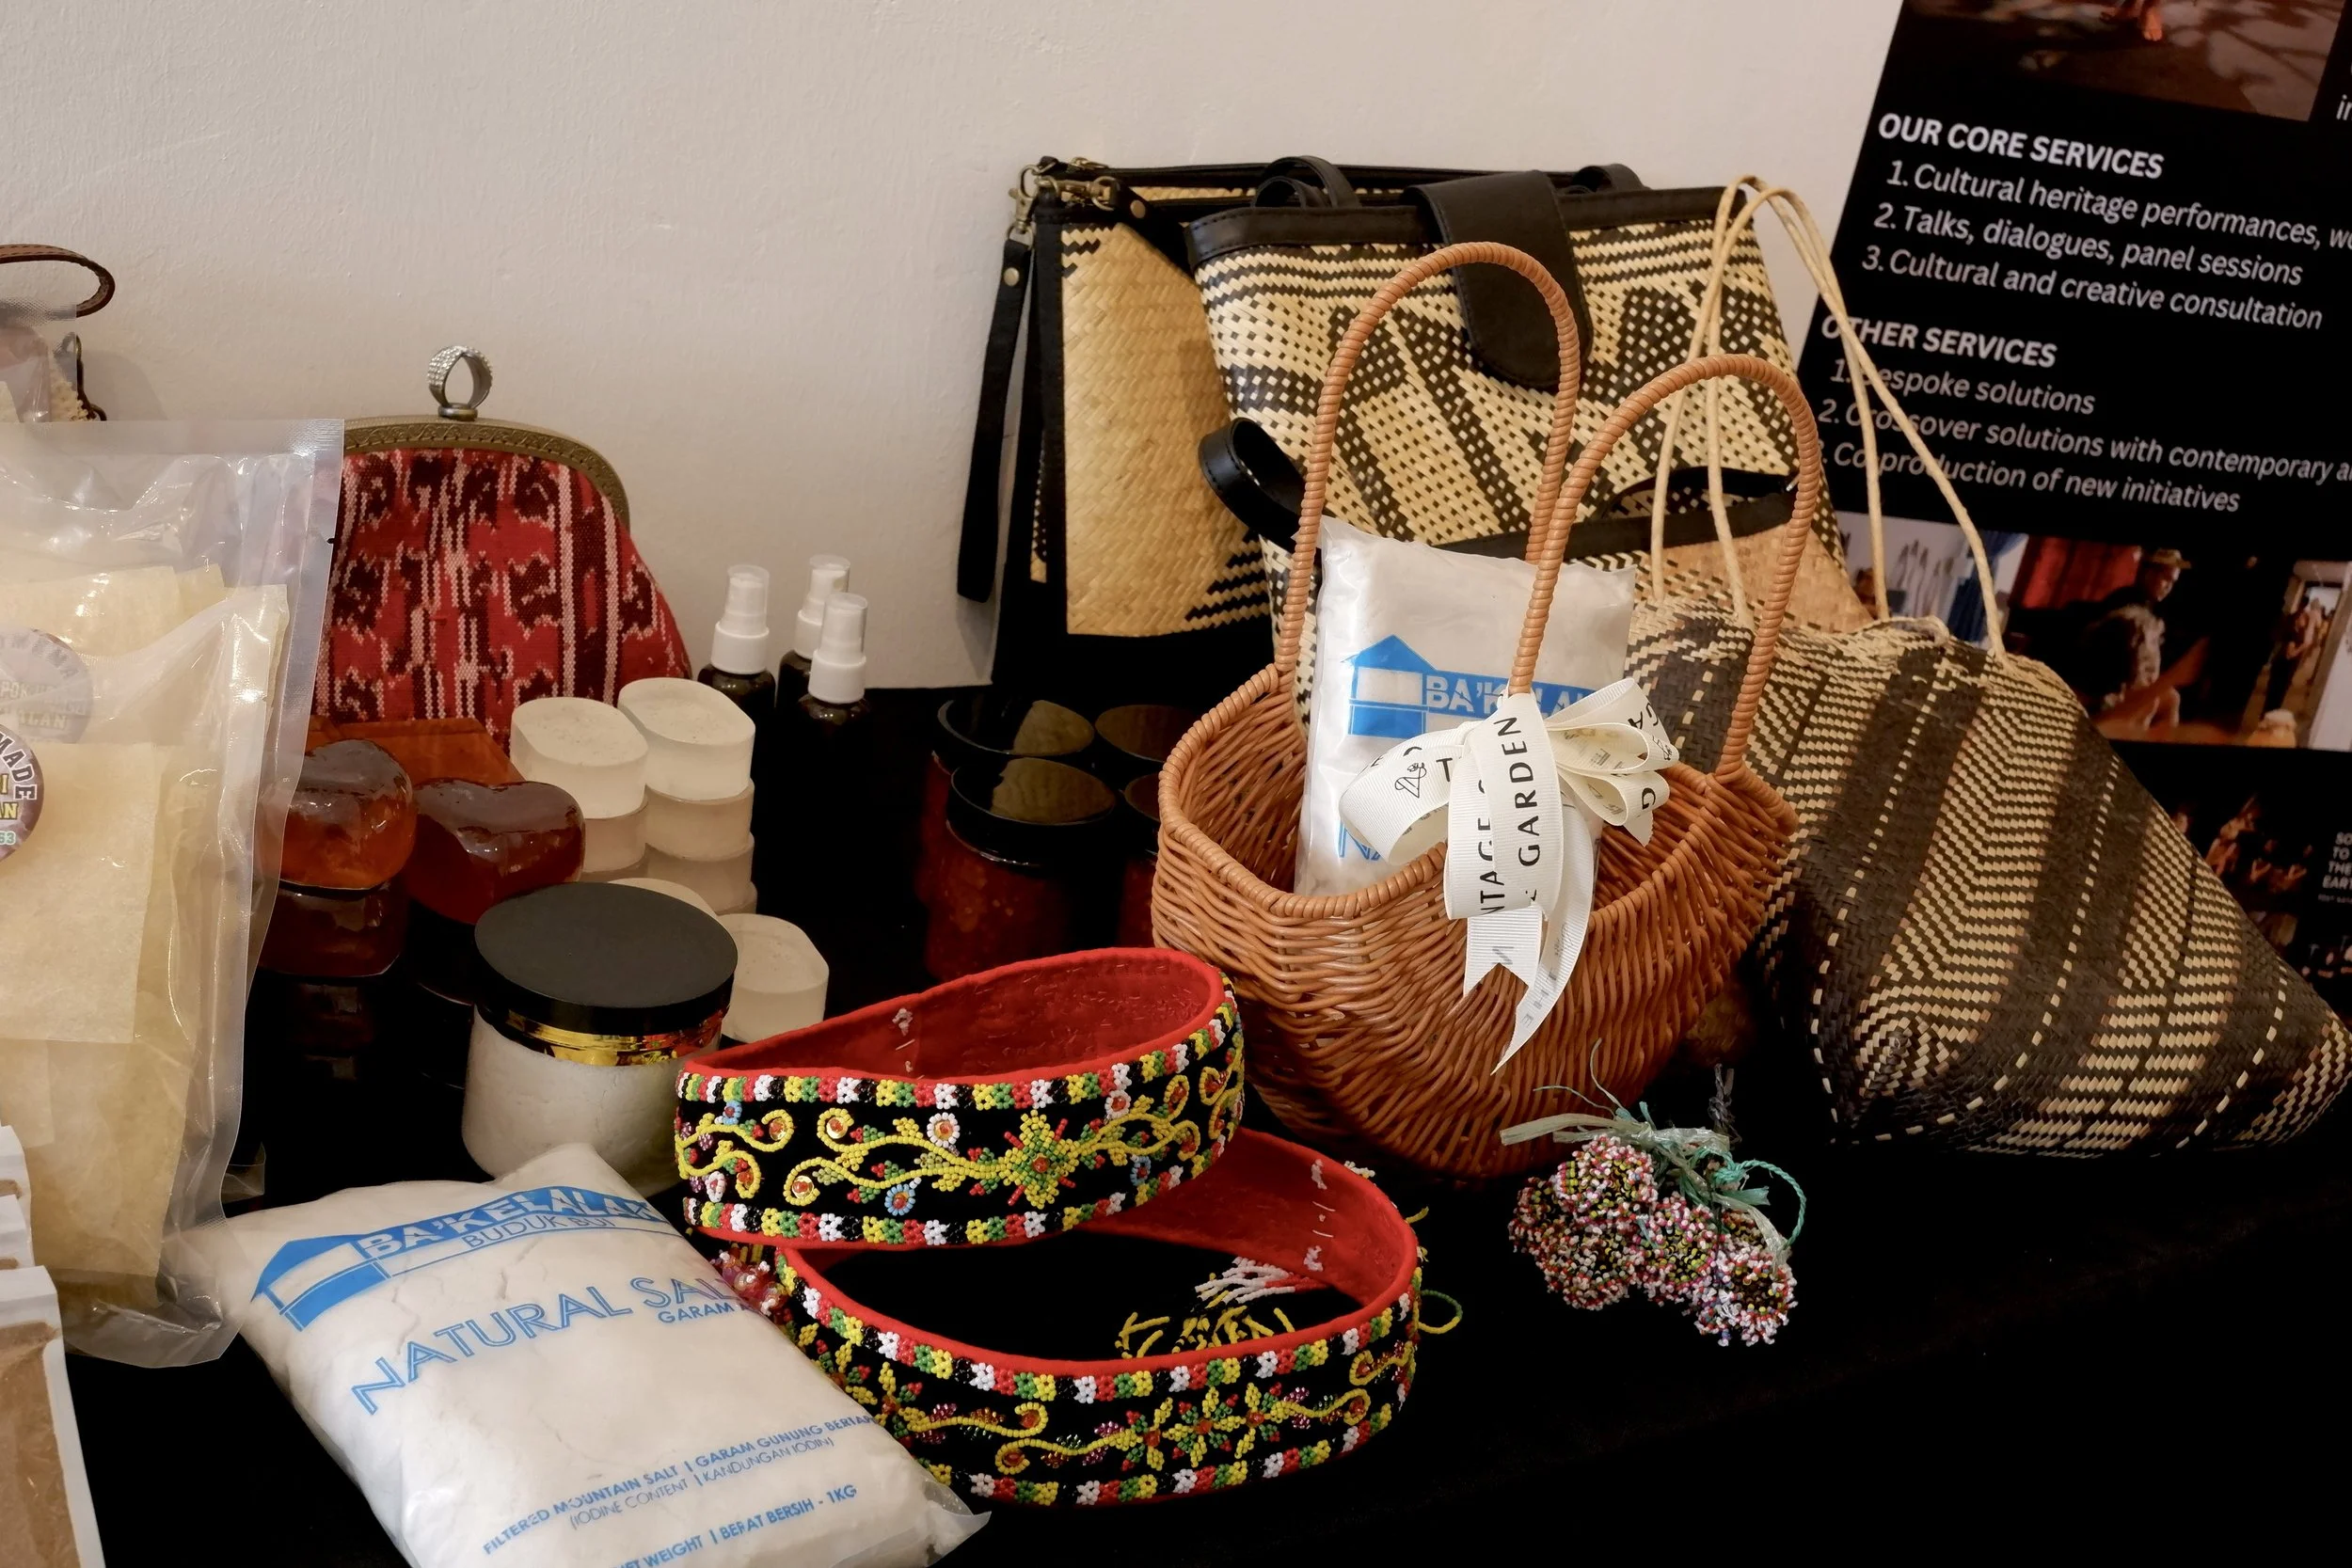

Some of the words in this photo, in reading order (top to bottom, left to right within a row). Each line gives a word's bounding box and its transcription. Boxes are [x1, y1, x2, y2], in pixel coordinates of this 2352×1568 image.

[1879, 113, 1943, 146] OUR
[1947, 123, 2028, 158] CORE
[2029, 135, 2164, 179] SERVICES
[1873, 202, 1897, 229] 2.
[1904, 205, 1974, 245] Talks,
[1983, 218, 2114, 265] dialogues,
[2121, 243, 2195, 271] panel
[2198, 254, 2303, 285] sessions
[1886, 160, 1908, 186] 1.
[1914, 164, 2025, 203] Cultural
[2028, 180, 2138, 224] heritage
[2141, 202, 2320, 250] performances,
[1862, 245, 1883, 271] 3.
[1890, 248, 1999, 287] Cultural
[2003, 269, 2058, 295] and
[2060, 277, 2165, 309] creative
[2169, 293, 2323, 329] consultation
[1922, 327, 2058, 368] SERVICES
[1864, 368, 1970, 398] espoke
[1975, 379, 2095, 415] solutions
[1818, 399, 1839, 423] 2.
[1985, 422, 2104, 456] solutions
[2110, 436, 2163, 464] with
[2169, 446, 2334, 485] contemporary
[2032, 467, 2064, 491] of
[2065, 475, 2119, 499] new
[2122, 476, 2240, 512] initiatives
[1493, 717, 1541, 866] GARDEN
[462, 1214, 566, 1247] BUDUK
[351, 1286, 633, 1416] NATURAL
[630, 1276, 739, 1308] SAL
[658, 1302, 735, 1323] GARAM
[483, 1509, 550, 1555] FILTERED
[553, 1478, 642, 1514] MOUNTAIN
[644, 1465, 678, 1485] SALT
[695, 1442, 755, 1467] GARAM
[756, 1425, 823, 1448] GUNUNG
[625, 1479, 689, 1509] CONTENT
[703, 1447, 791, 1481] KANDUNGAN
[644, 1535, 704, 1568] WEIGHT
[766, 1498, 815, 1524] BERSIH
[826, 1484, 857, 1504] 1KG
